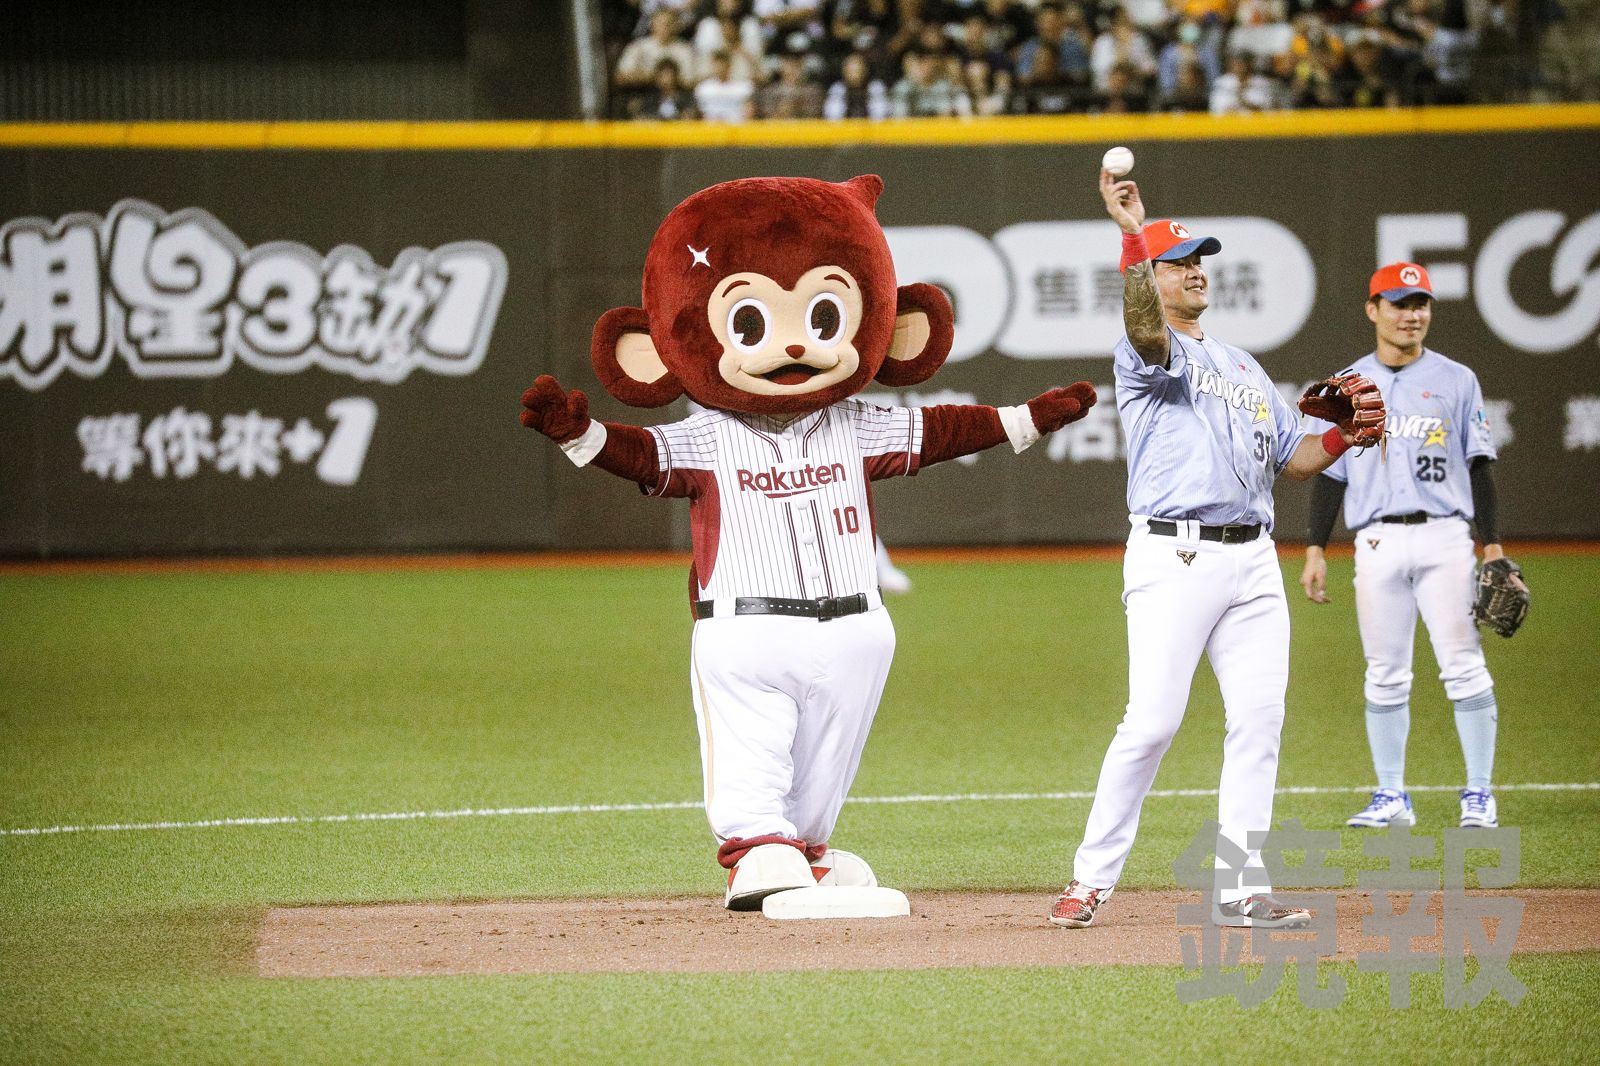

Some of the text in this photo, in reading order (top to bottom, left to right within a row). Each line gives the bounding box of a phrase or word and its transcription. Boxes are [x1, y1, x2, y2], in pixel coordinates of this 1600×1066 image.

[737, 463, 847, 493] Rakuten
[1416, 455, 1447, 483] 25
[833, 506, 860, 536] 10
